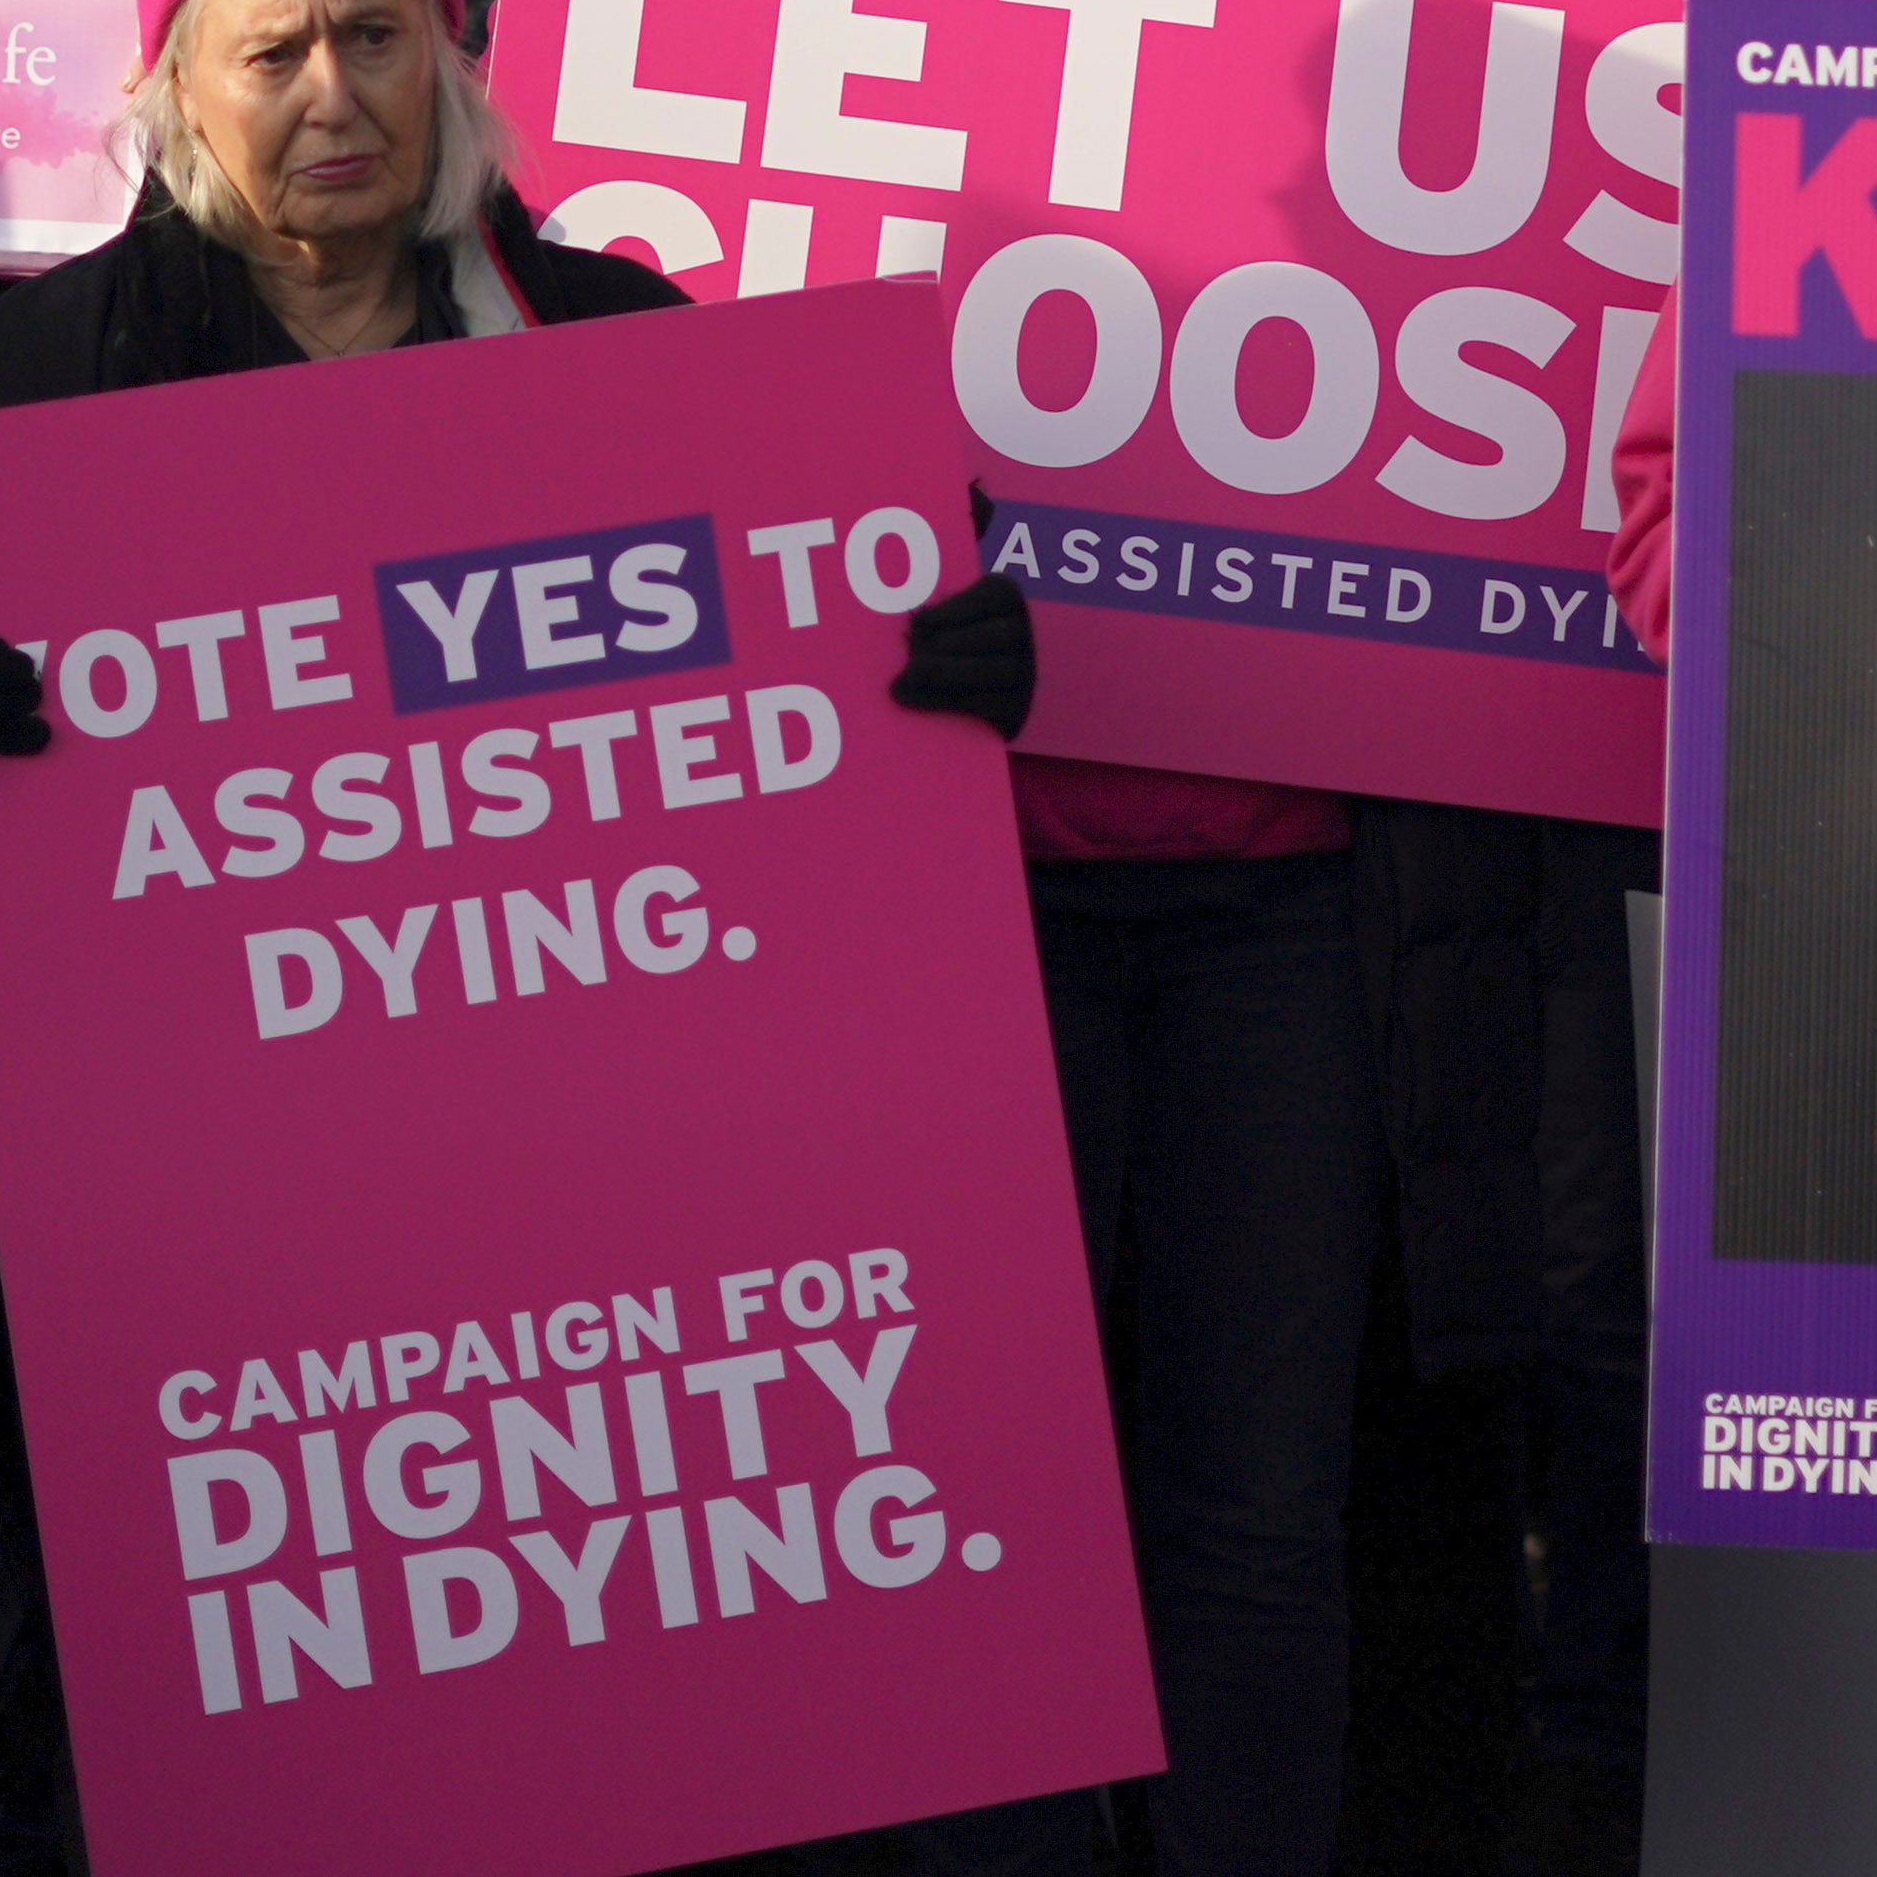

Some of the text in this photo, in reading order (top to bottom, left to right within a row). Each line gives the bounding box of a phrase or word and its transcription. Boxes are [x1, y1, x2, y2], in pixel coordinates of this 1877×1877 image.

[18, 505, 942, 738] OTE YES TO
[991, 522, 1646, 652] ASSISTED DYI
[112, 684, 843, 900] ASSISTED
[244, 864, 758, 1040] DYING.
[158, 1246, 916, 1441] CAMPAIGN FOR
[1705, 1393, 1854, 1419] CAMPAIGN
[166, 1323, 918, 1581] DIGNITY
[1703, 1454, 1753, 1491] IN
[187, 1463, 1002, 1716] IN DYING.
